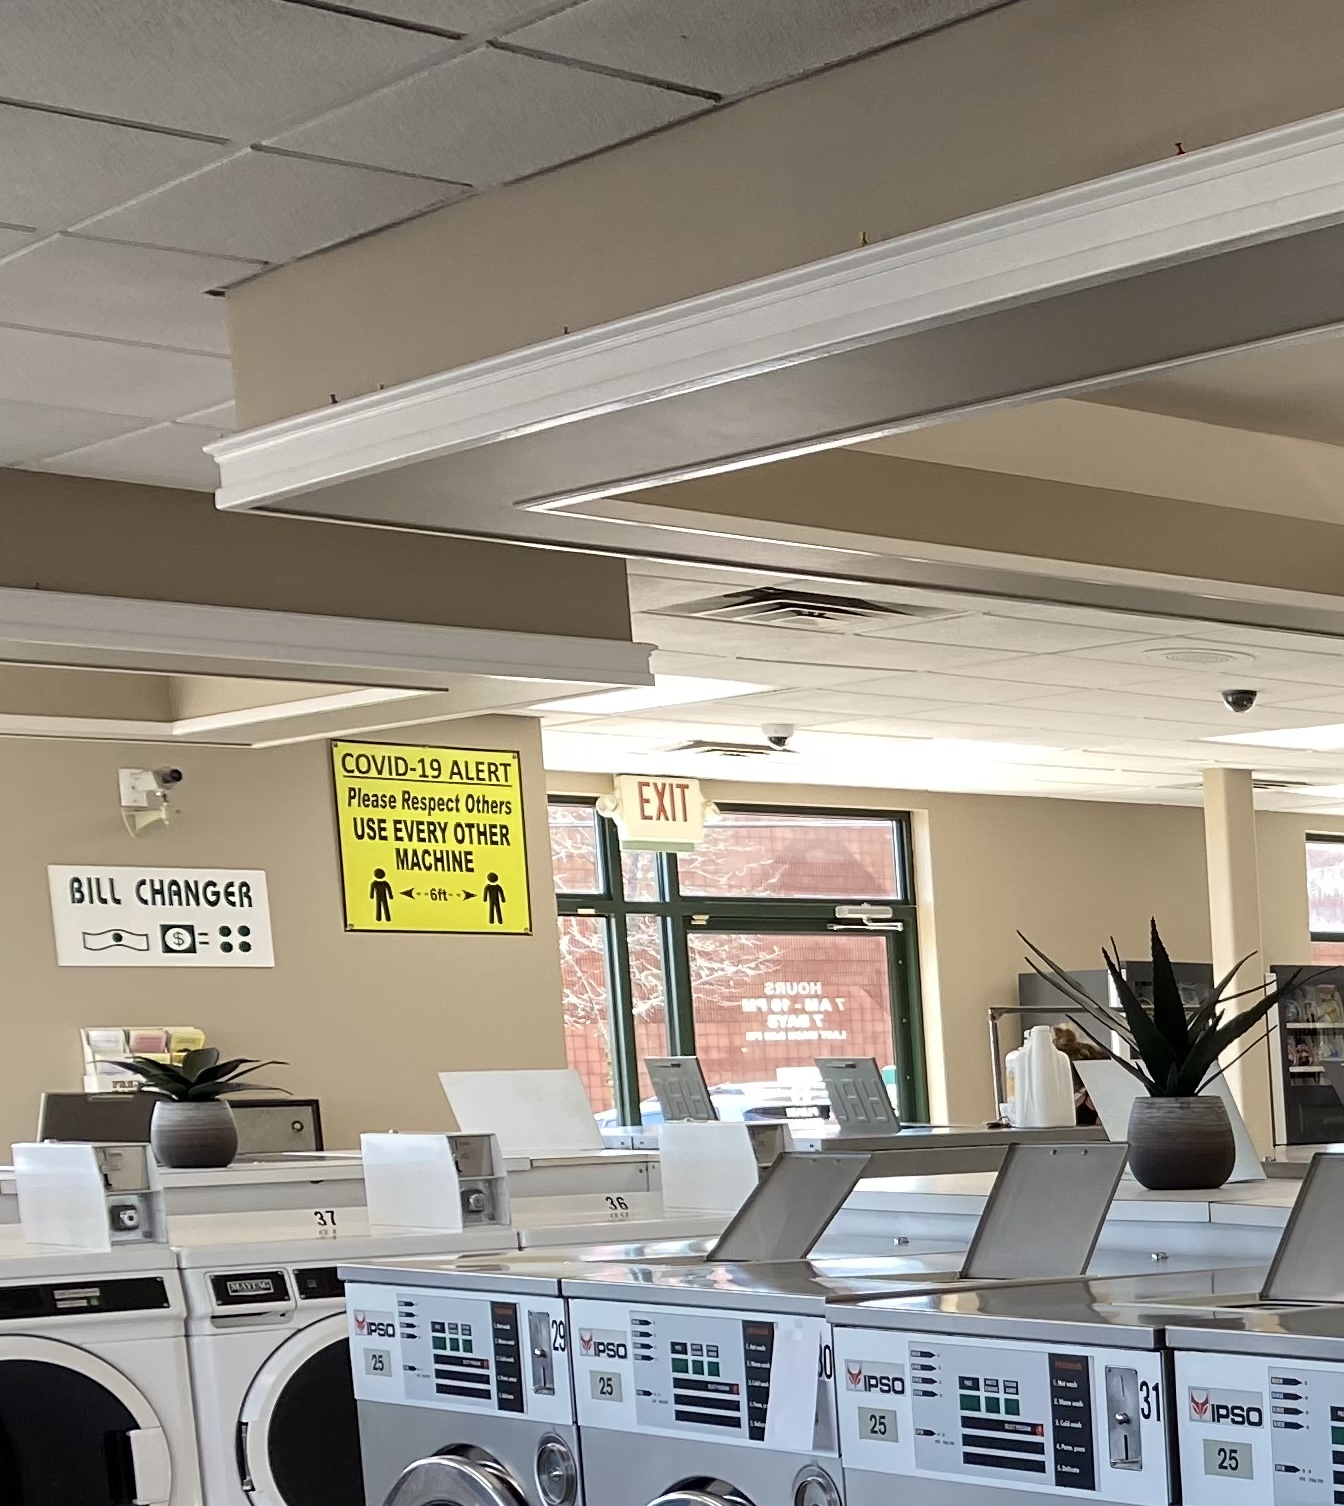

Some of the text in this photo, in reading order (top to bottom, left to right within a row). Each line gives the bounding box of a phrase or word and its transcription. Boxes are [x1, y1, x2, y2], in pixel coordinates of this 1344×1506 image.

[341, 752, 512, 783] COVID-19 ALERT
[347, 787, 513, 816] Please Respect Others
[638, 781, 690, 823] EXIT
[353, 817, 511, 847] USE EVERY OTHER
[395, 848, 475, 873] MACHINE
[69, 876, 254, 909] BILL CHANGER
[605, 1196, 629, 1211] 36
[313, 1210, 337, 1227] 37
[367, 1321, 395, 1339] IPSO
[552, 1318, 566, 1352] 29
[594, 1341, 627, 1360] IPSO
[371, 1355, 384, 1372] 25
[599, 1377, 614, 1396] 25
[863, 1375, 905, 1395] IPSO
[1139, 1380, 1161, 1422] 31
[869, 1414, 887, 1436] 25
[1211, 1403, 1263, 1428] IPSO
[1217, 1448, 1239, 1471] 25
